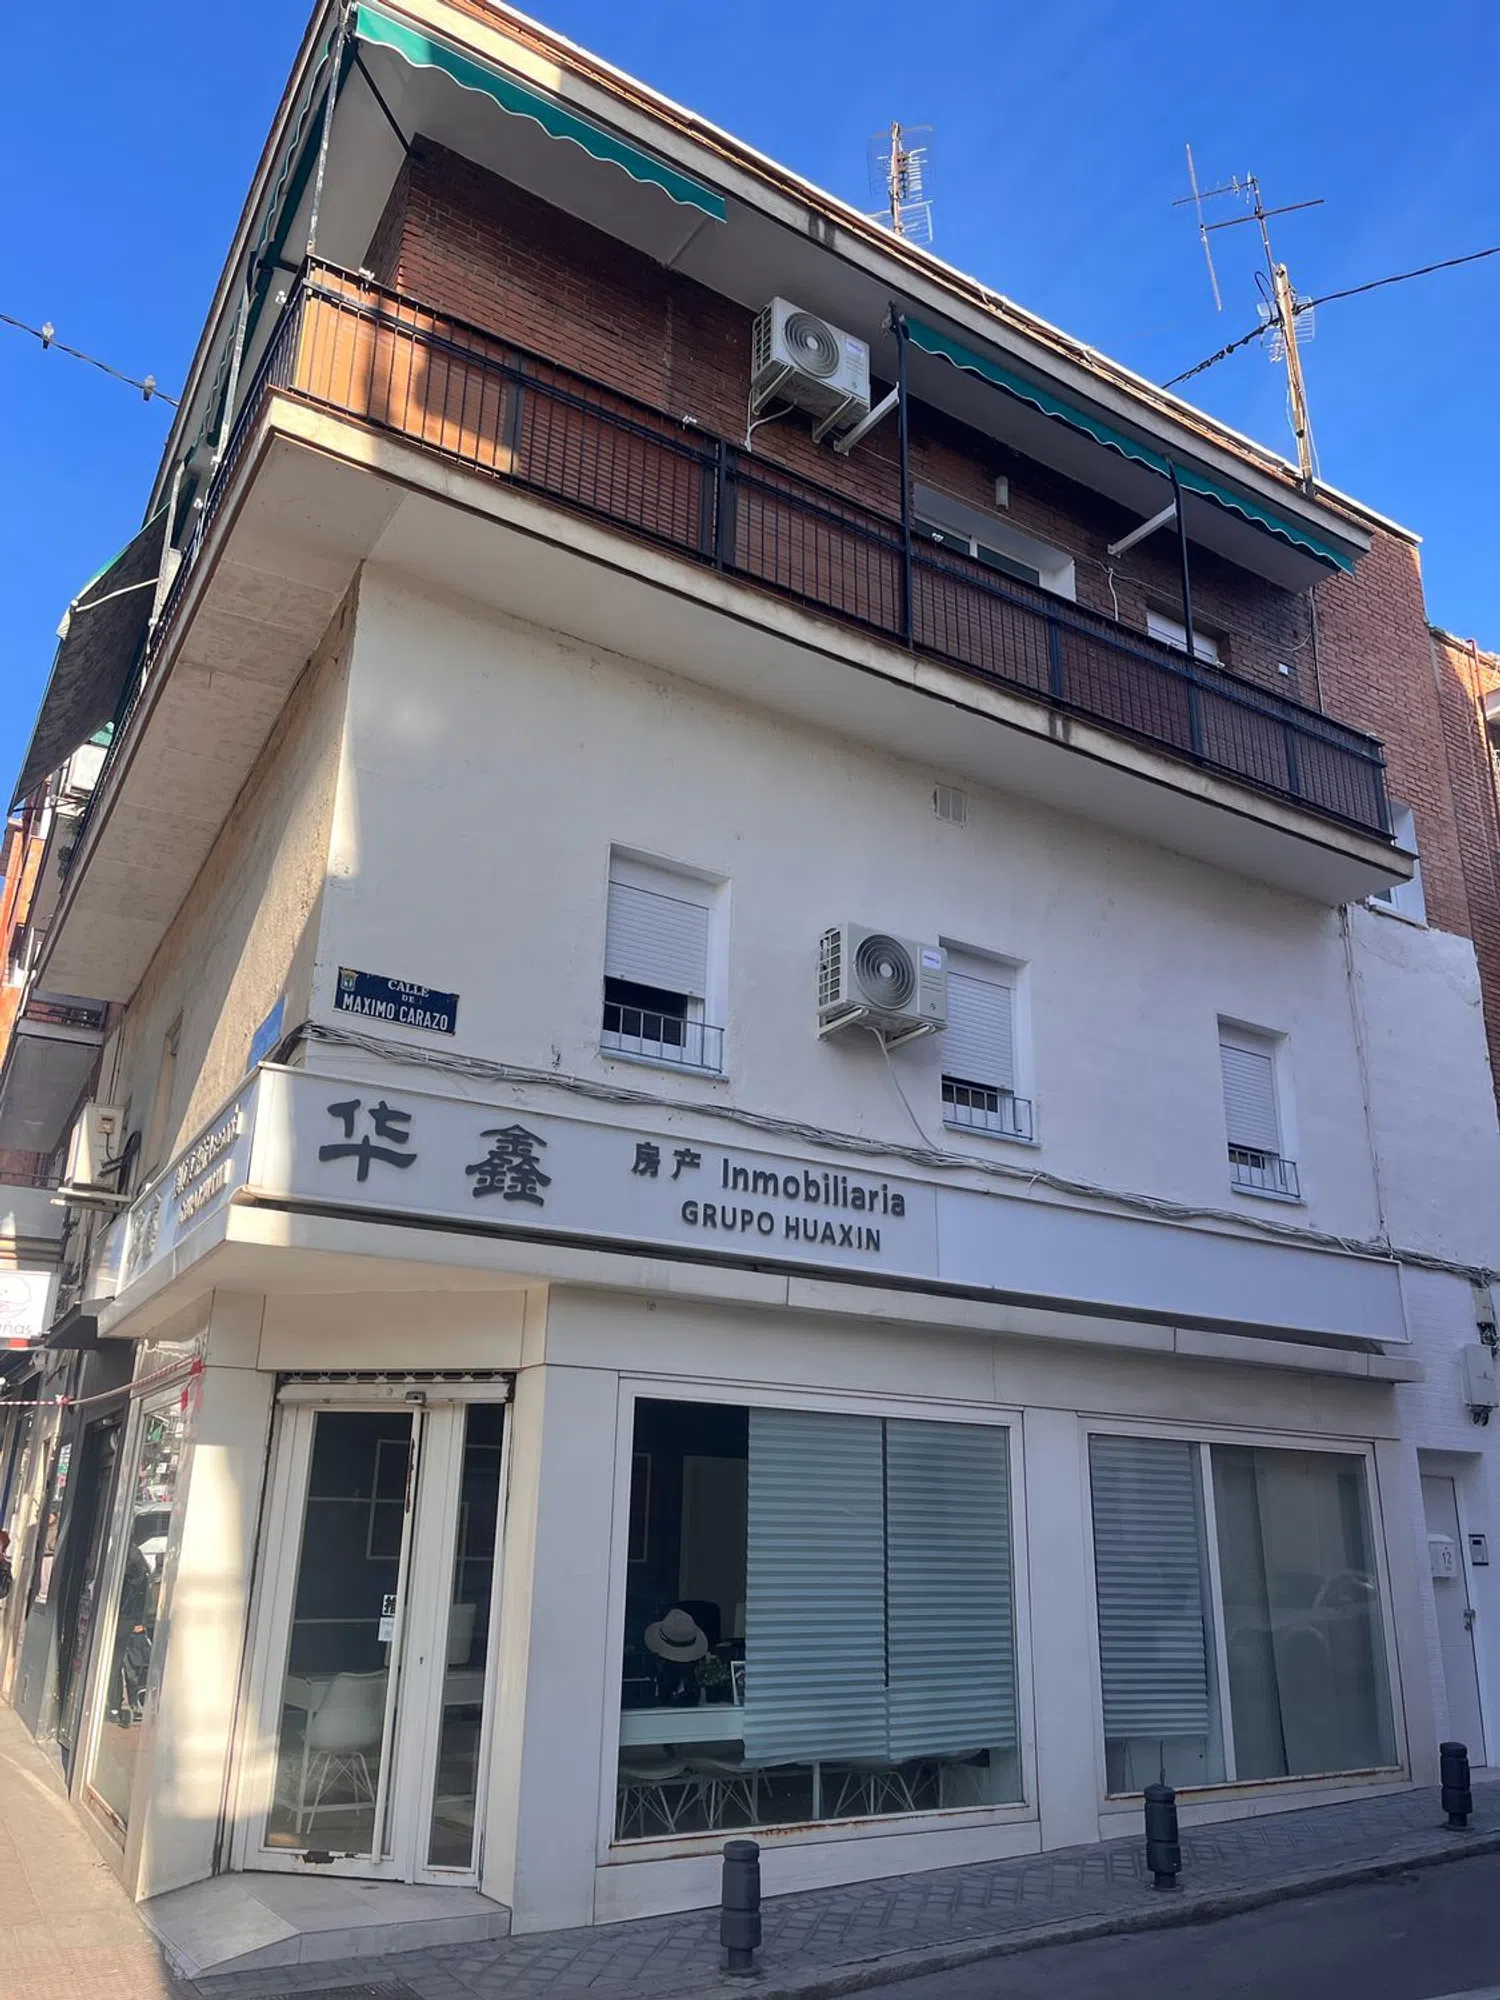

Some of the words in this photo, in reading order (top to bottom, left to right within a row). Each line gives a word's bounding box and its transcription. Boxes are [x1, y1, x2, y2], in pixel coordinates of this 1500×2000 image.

[388, 981, 429, 998] CALLE
[401, 994, 415, 1003] DE
[343, 994, 395, 1020] MAXIMO
[399, 1006, 448, 1031] CARAZO
[631, 1141, 702, 1181] 房产
[721, 1157, 907, 1217] Inmobiliaria
[681, 1200, 775, 1236] GRUPO
[783, 1215, 882, 1252] HUAXIN
[0, 1321, 32, 1335] ñas
